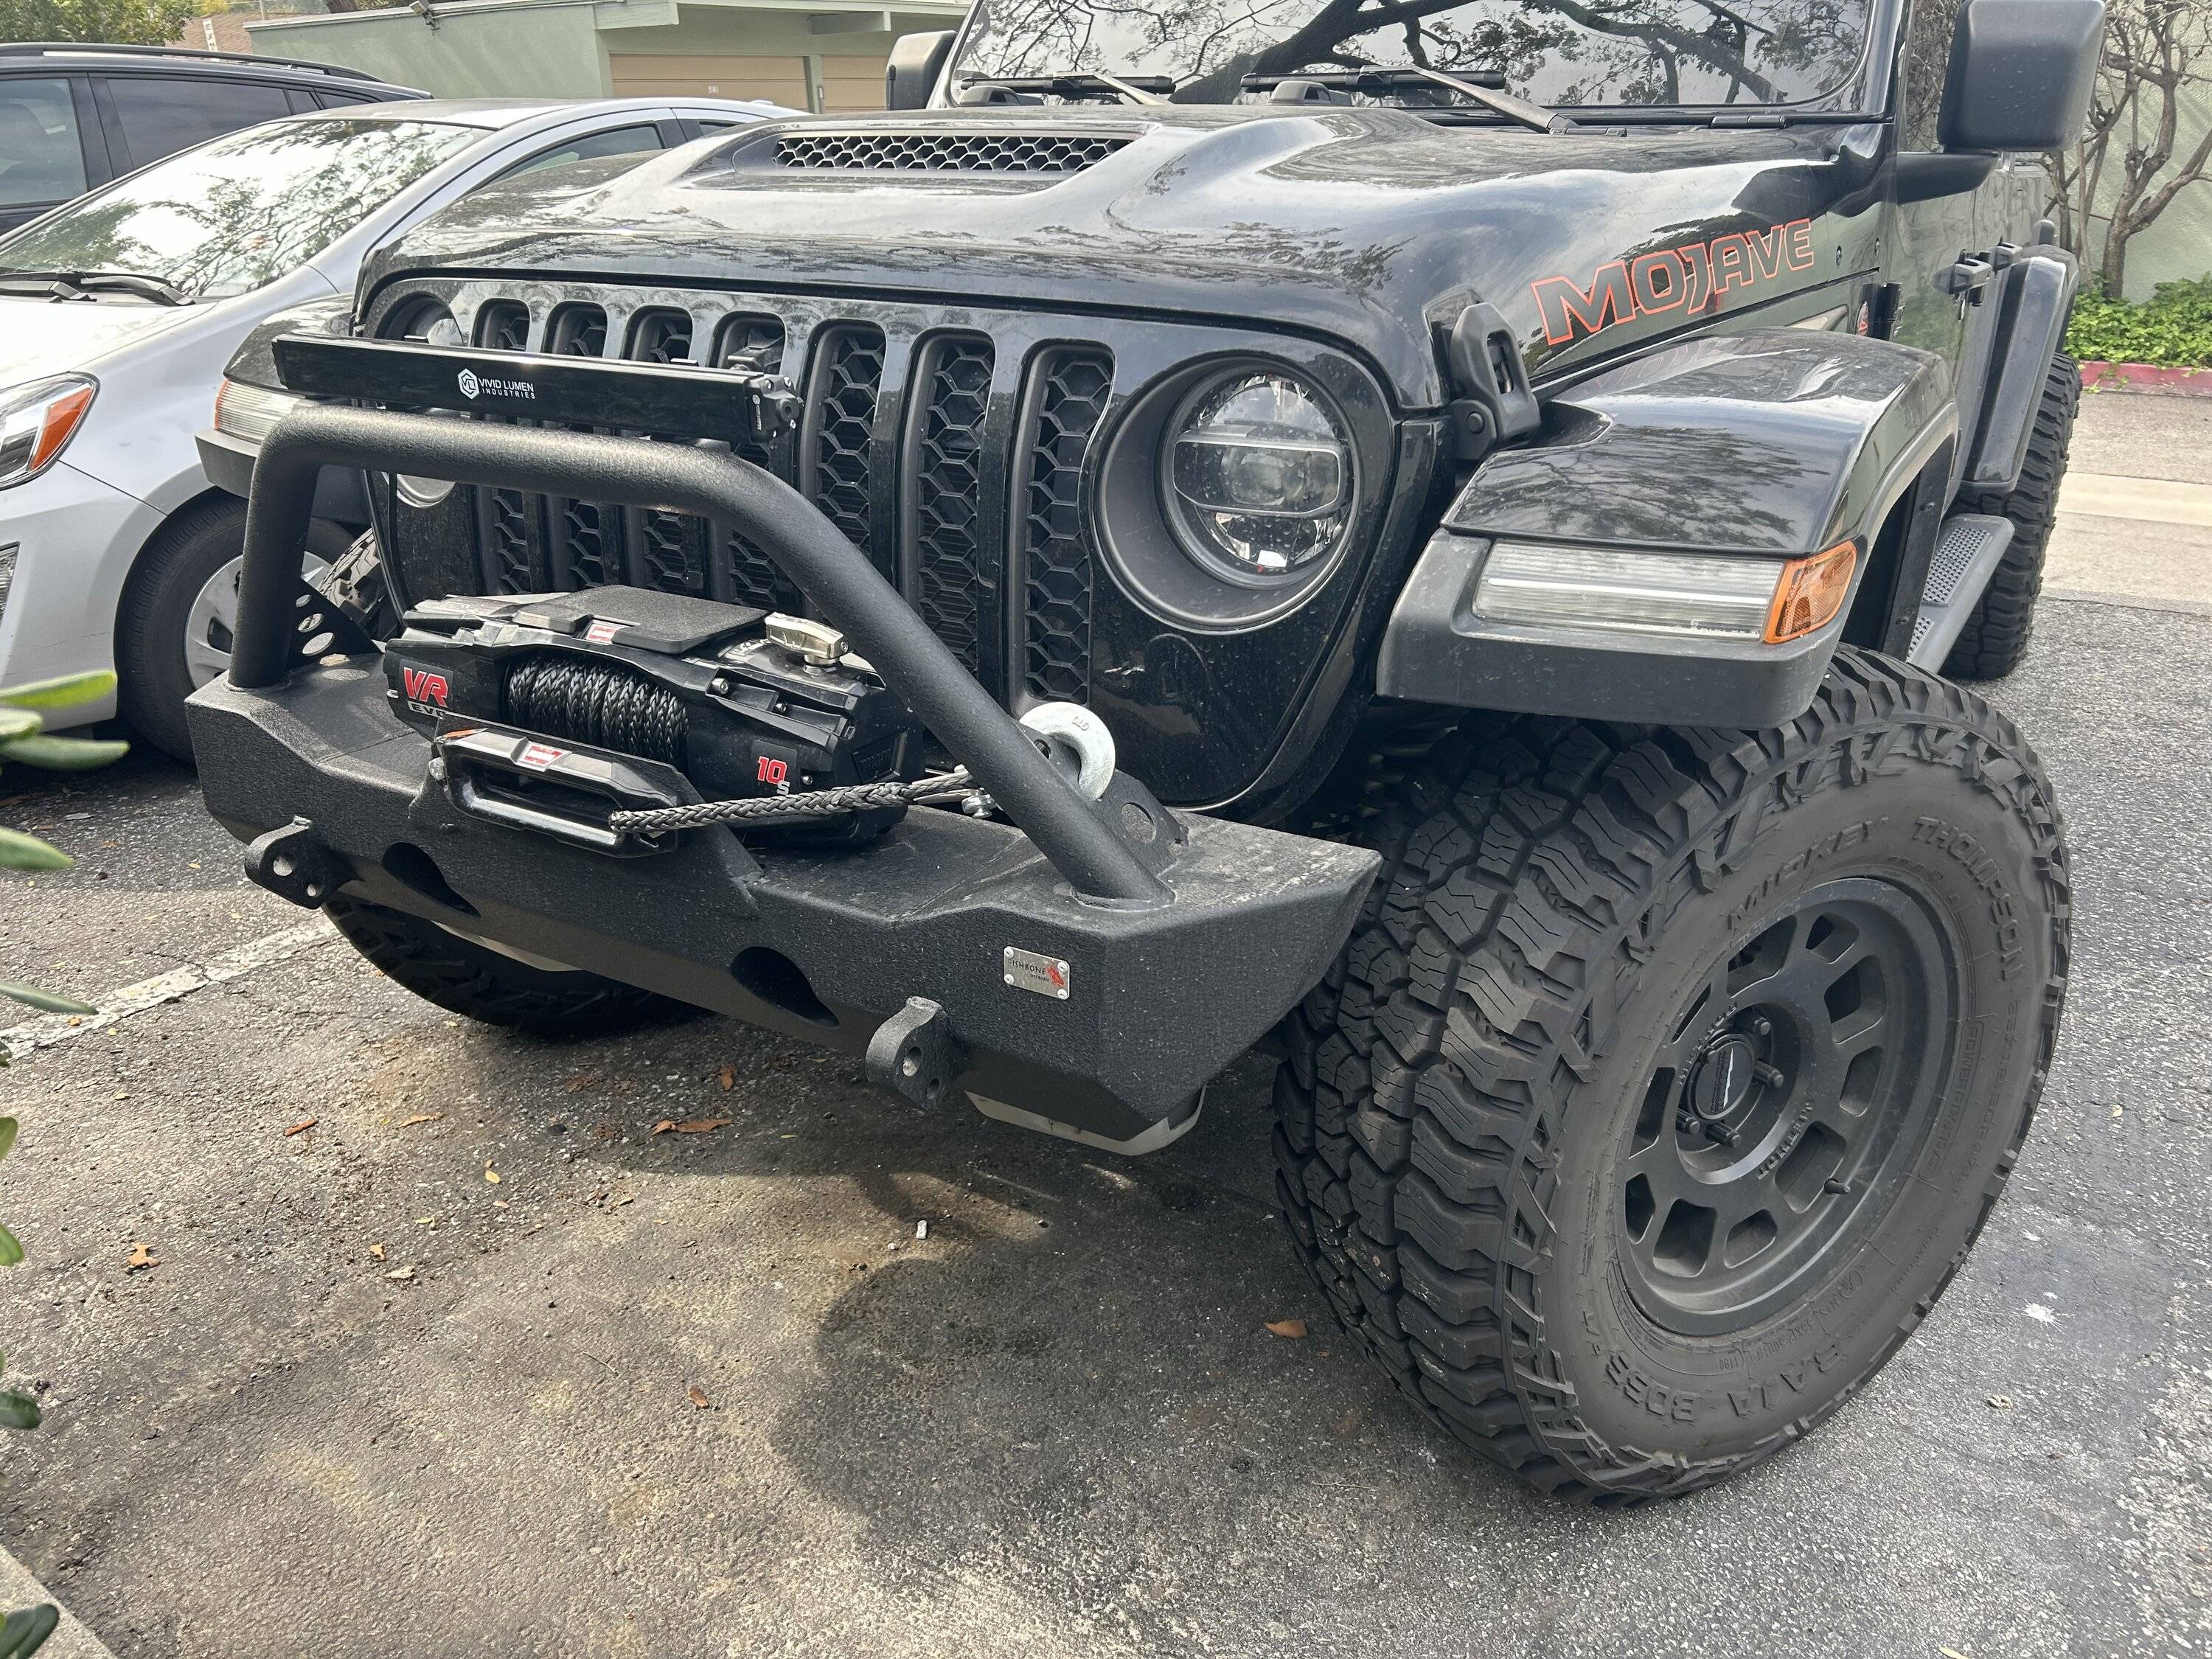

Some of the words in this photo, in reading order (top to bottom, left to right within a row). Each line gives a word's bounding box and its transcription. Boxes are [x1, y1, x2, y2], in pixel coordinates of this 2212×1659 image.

[1531, 218, 1815, 346] MOJAVE
[478, 378, 502, 389] VIVID
[503, 380, 535, 392] LUMEN
[481, 388, 536, 400] INDUSTRIES
[403, 667, 448, 708] VR
[757, 756, 787, 785] 10
[1724, 815, 1890, 932] MICKEY
[1911, 815, 2028, 982] THOMPSON
[1007, 959, 1047, 975] FISHBONE
[1604, 1352, 1697, 1423] BOSS
[1726, 1341, 1842, 1418] BAJA
